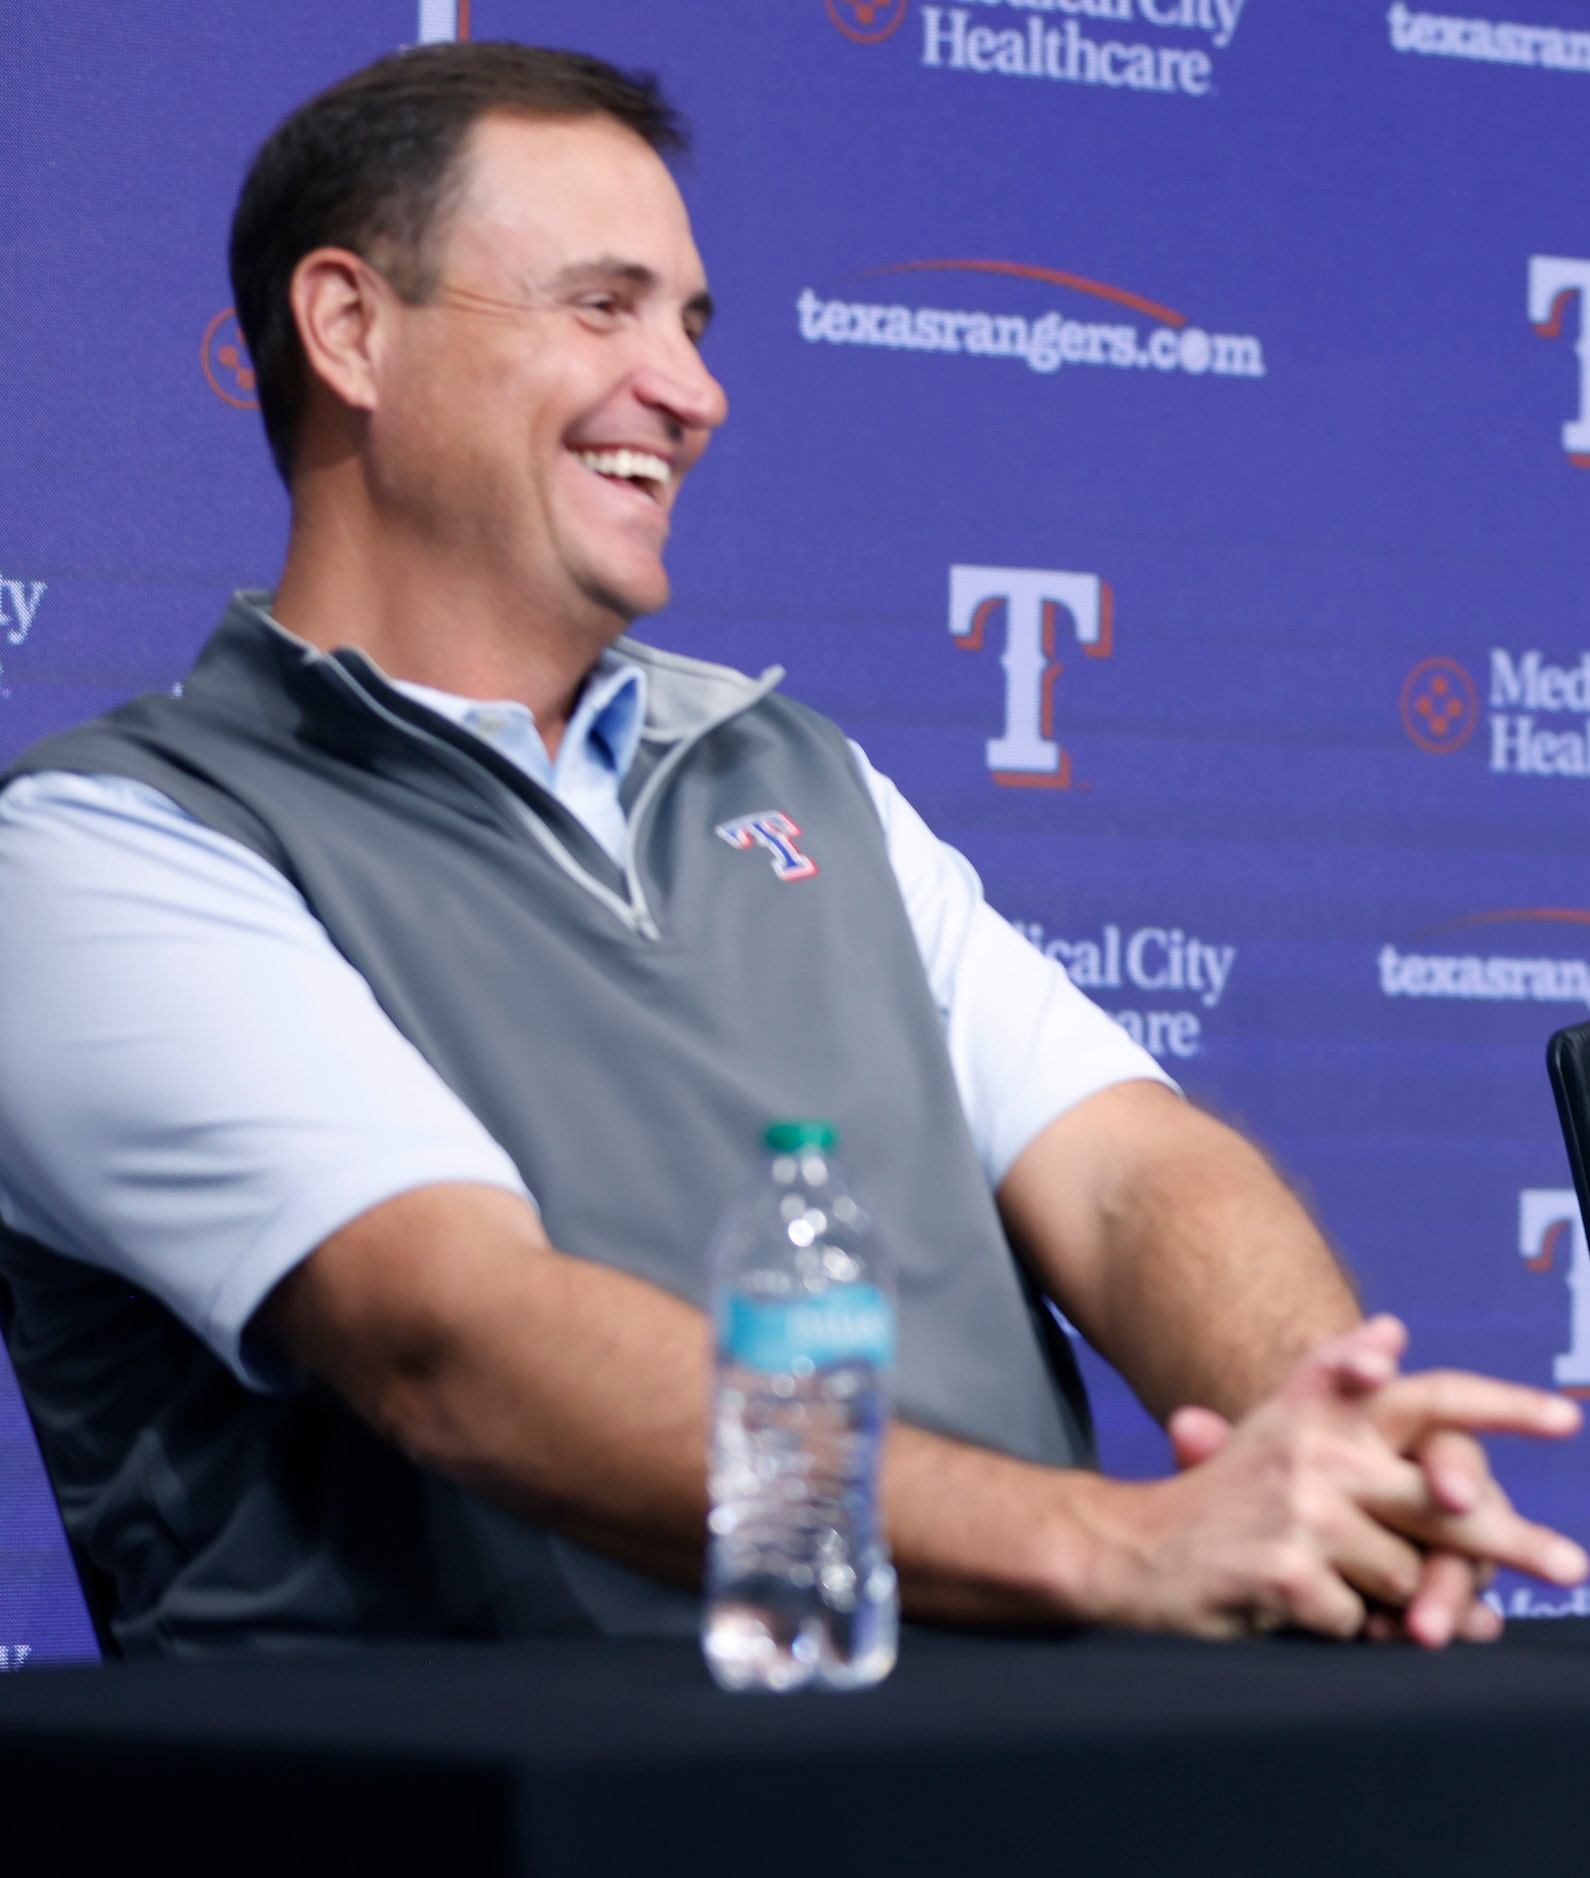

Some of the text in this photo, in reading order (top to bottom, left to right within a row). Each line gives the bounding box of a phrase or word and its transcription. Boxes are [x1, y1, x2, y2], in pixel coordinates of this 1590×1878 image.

[921, 5, 1213, 97] Healthcare
[797, 288, 1266, 378] texasrangers.com
[948, 564, 1114, 790] T
[713, 808, 820, 883] T
[1125, 926, 1236, 1009] City
